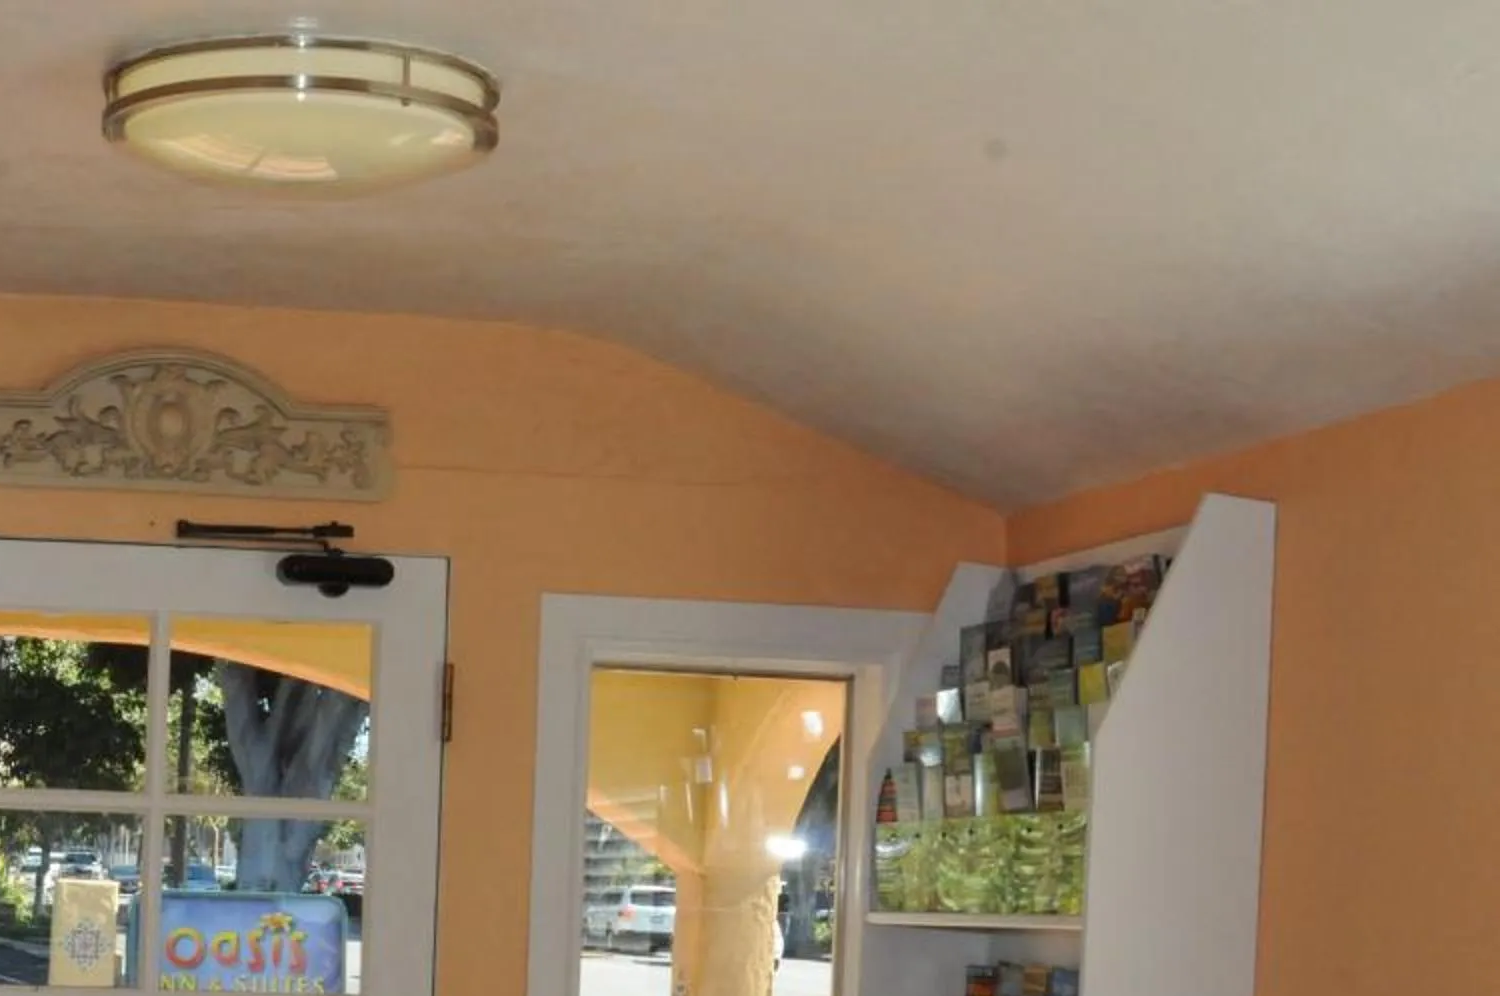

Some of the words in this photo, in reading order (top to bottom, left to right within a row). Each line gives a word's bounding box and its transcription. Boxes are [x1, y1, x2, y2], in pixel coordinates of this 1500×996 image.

[164, 914, 308, 973] Oasis
[158, 974, 197, 991] NN
[233, 974, 326, 995] SUITES
